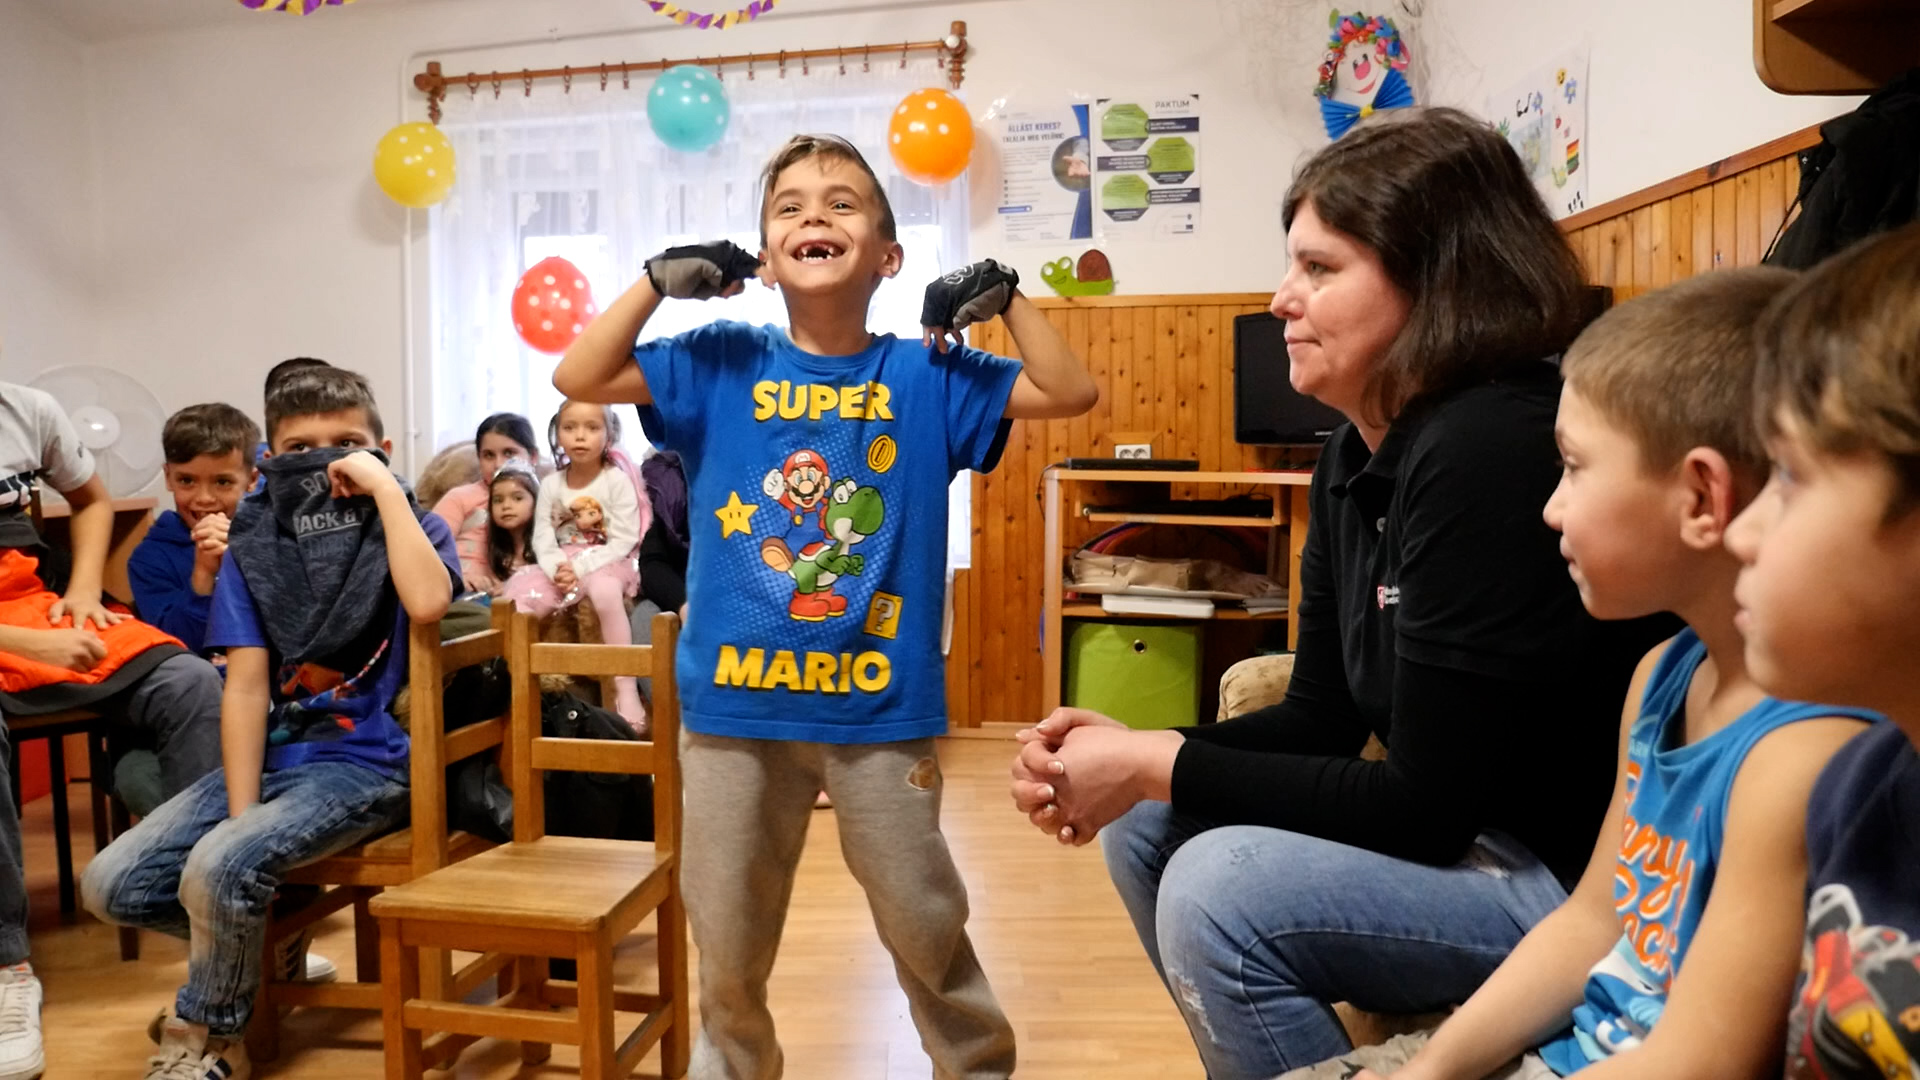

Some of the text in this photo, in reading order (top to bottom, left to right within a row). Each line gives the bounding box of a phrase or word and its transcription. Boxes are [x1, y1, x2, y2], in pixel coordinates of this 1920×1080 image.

[1155, 100, 1190, 108] PAKTUM
[753, 380, 894, 421] SUPER
[713, 645, 892, 694] MARIO
